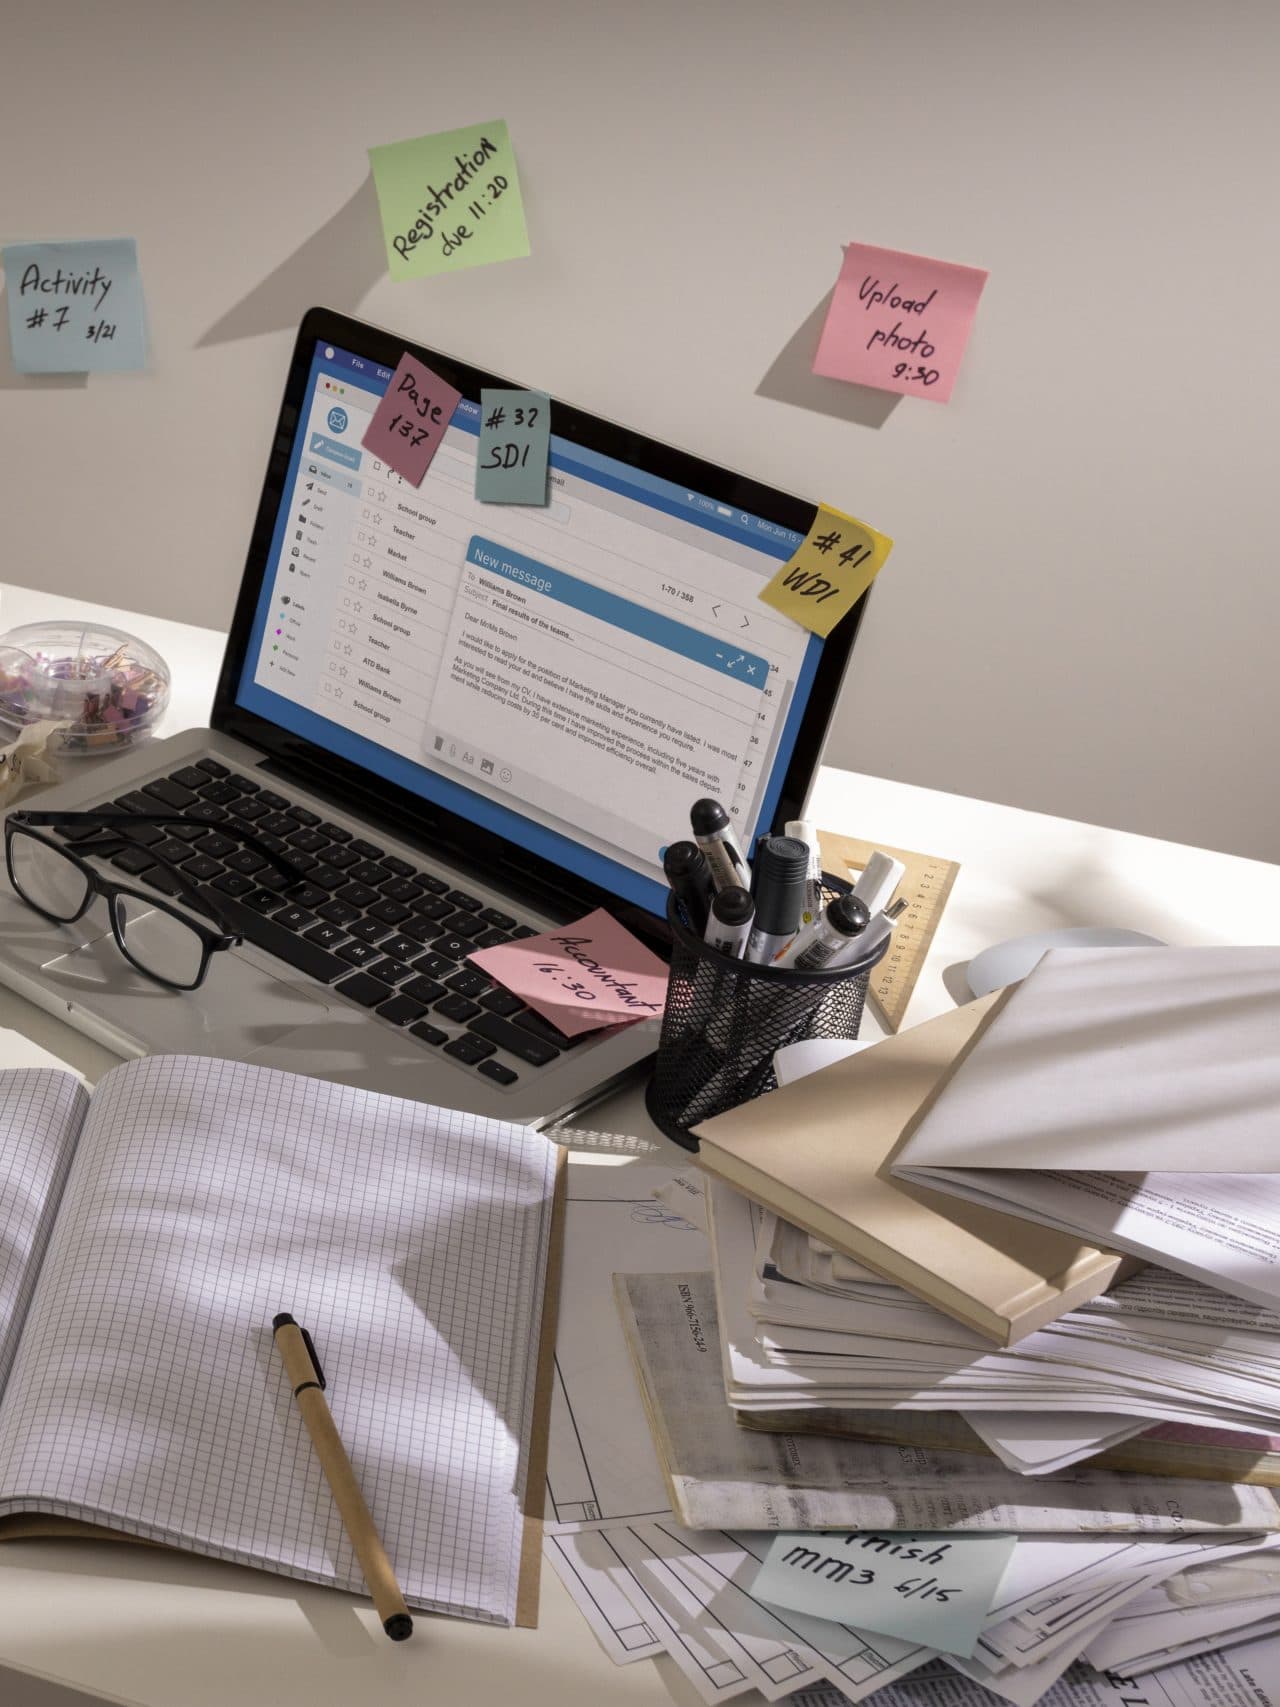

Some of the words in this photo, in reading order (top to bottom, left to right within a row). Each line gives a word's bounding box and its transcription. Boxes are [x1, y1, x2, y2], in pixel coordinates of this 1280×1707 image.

[441, 225, 474, 256] due
[468, 175, 509, 220] 11:20
[20, 263, 112, 312] Activity
[859, 275, 938, 316] Upload
[866, 322, 935, 358] photo
[351, 357, 364, 369] File
[376, 368, 390, 380] Edit
[388, 413, 430, 447] 137
[397, 503, 418, 517] School
[418, 513, 436, 526] group
[392, 524, 416, 541] Teacher
[387, 547, 407, 562] Market
[382, 569, 406, 586] Williams
[407, 580, 427, 595] Brown
[473, 548, 499, 569] New
[501, 560, 553, 595] message
[478, 577, 505, 595] Williams
[505, 589, 527, 604] Brown
[372, 613, 393, 628] School
[392, 623, 411, 637] group
[464, 611, 479, 624] Dear
[498, 626, 518, 642] Brown
[491, 598, 508, 611] Final
[507, 605, 530, 621] results
[538, 619, 549, 630] the
[368, 635, 390, 651] Teacher
[820, 1531, 953, 1565] inish
[894, 1577, 963, 1602] 6/15
